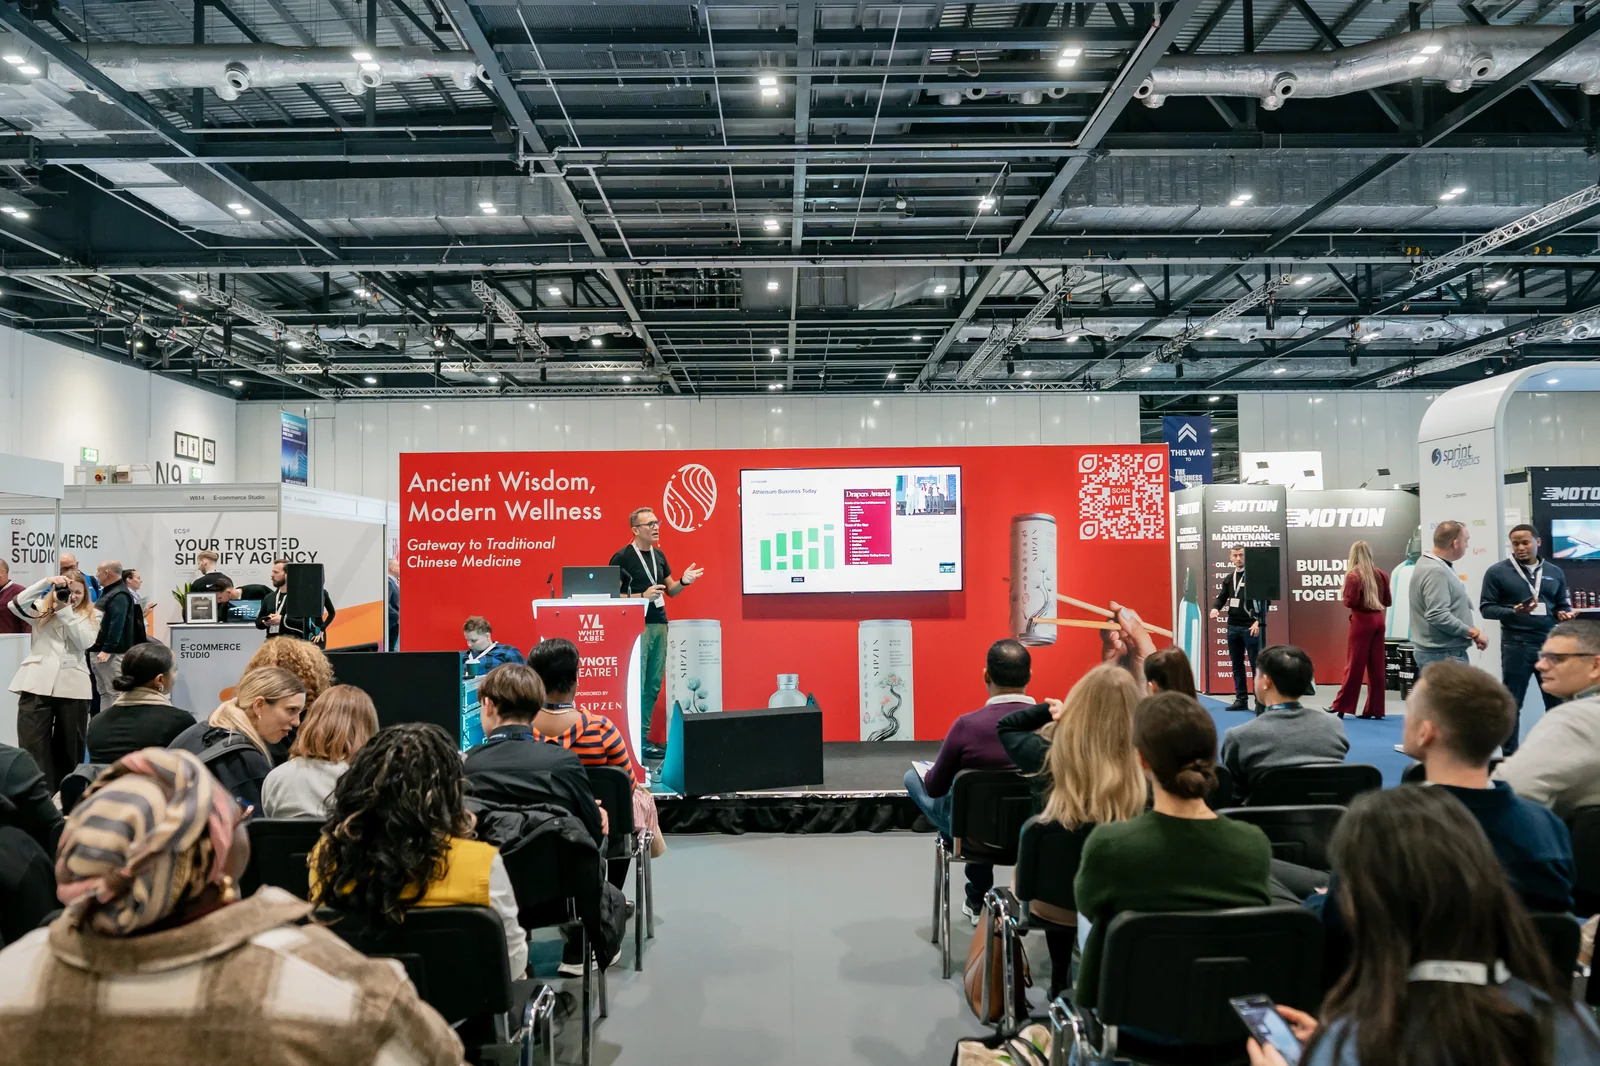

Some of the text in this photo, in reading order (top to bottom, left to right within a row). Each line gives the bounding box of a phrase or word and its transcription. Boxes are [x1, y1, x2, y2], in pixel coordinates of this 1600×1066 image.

[1443, 444, 1472, 465] sprint
[407, 469, 596, 494] Ancient Wisdom,
[1112, 495, 1131, 505] ME
[1549, 487, 1600, 500] MOTO
[408, 499, 601, 522] Modern Wellness
[1219, 500, 1278, 512] MOTON
[1295, 508, 1386, 528] MOTON
[12, 531, 98, 548] E-COMMERCE
[175, 538, 299, 551] YOUR TRUSTED
[407, 536, 556, 554] Gateway to Traditional
[174, 552, 245, 565] SHIFY
[407, 554, 521, 568] Chinese Medicine
[1296, 560, 1349, 572] BUILDI
[1301, 574, 1344, 586] BRAN
[1292, 589, 1343, 601] TOGET
[180, 643, 241, 651] E-COMMERCE
[579, 656, 617, 666] YNOTE
[579, 667, 618, 677] EATRE 1
[580, 702, 622, 710] SIPZEN
